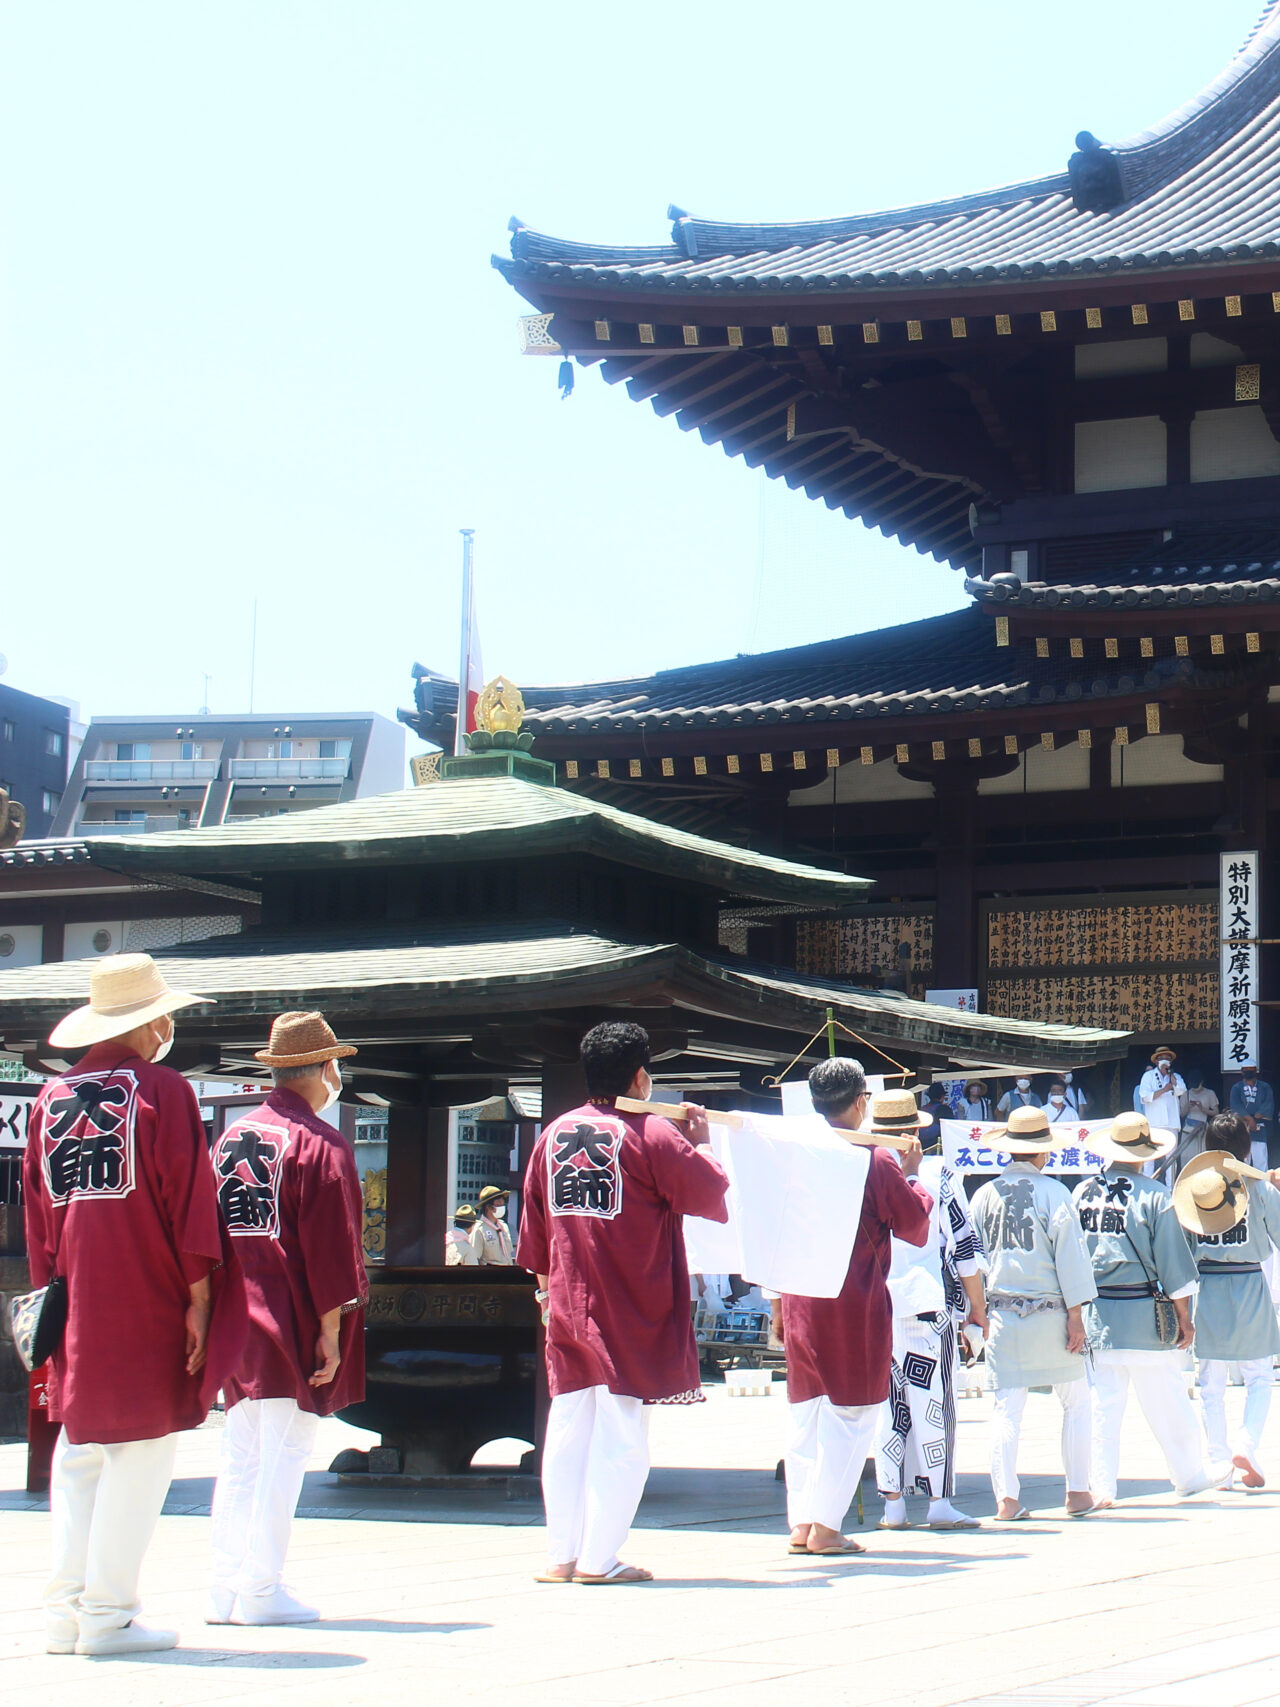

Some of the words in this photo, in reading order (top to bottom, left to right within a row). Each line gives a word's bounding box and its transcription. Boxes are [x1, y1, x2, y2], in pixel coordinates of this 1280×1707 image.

[1227, 861, 1252, 1063] 特別大護摩祈願芳名
[47, 1081, 128, 1197] 大師
[219, 1128, 280, 1233] 大師
[552, 1121, 619, 1213] 大師
